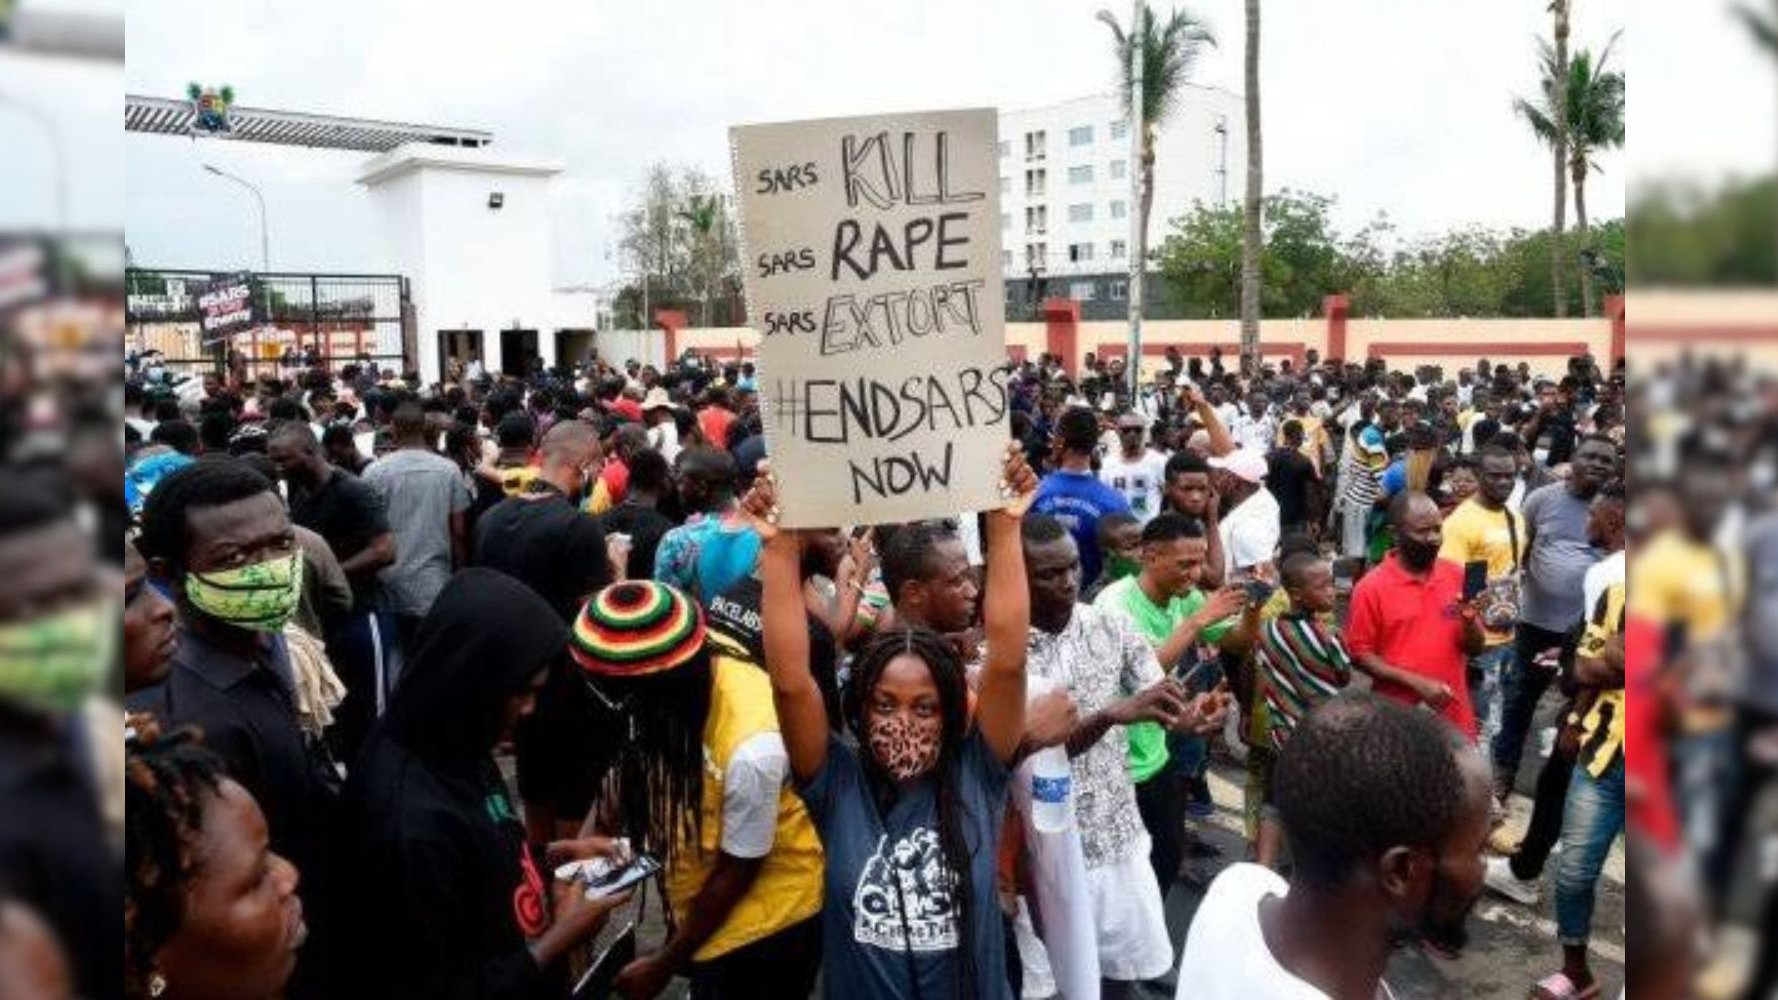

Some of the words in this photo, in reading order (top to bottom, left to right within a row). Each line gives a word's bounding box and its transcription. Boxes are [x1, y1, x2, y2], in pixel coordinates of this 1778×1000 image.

[756, 161, 819, 195] SARS
[842, 130, 986, 211] KILL
[758, 248, 816, 279] SARS
[832, 212, 969, 282] RAPE
[764, 311, 817, 337] SARS
[819, 279, 986, 357] EXTORT
[774, 366, 1010, 443] #ENDSARS
[849, 442, 954, 505] NOW
